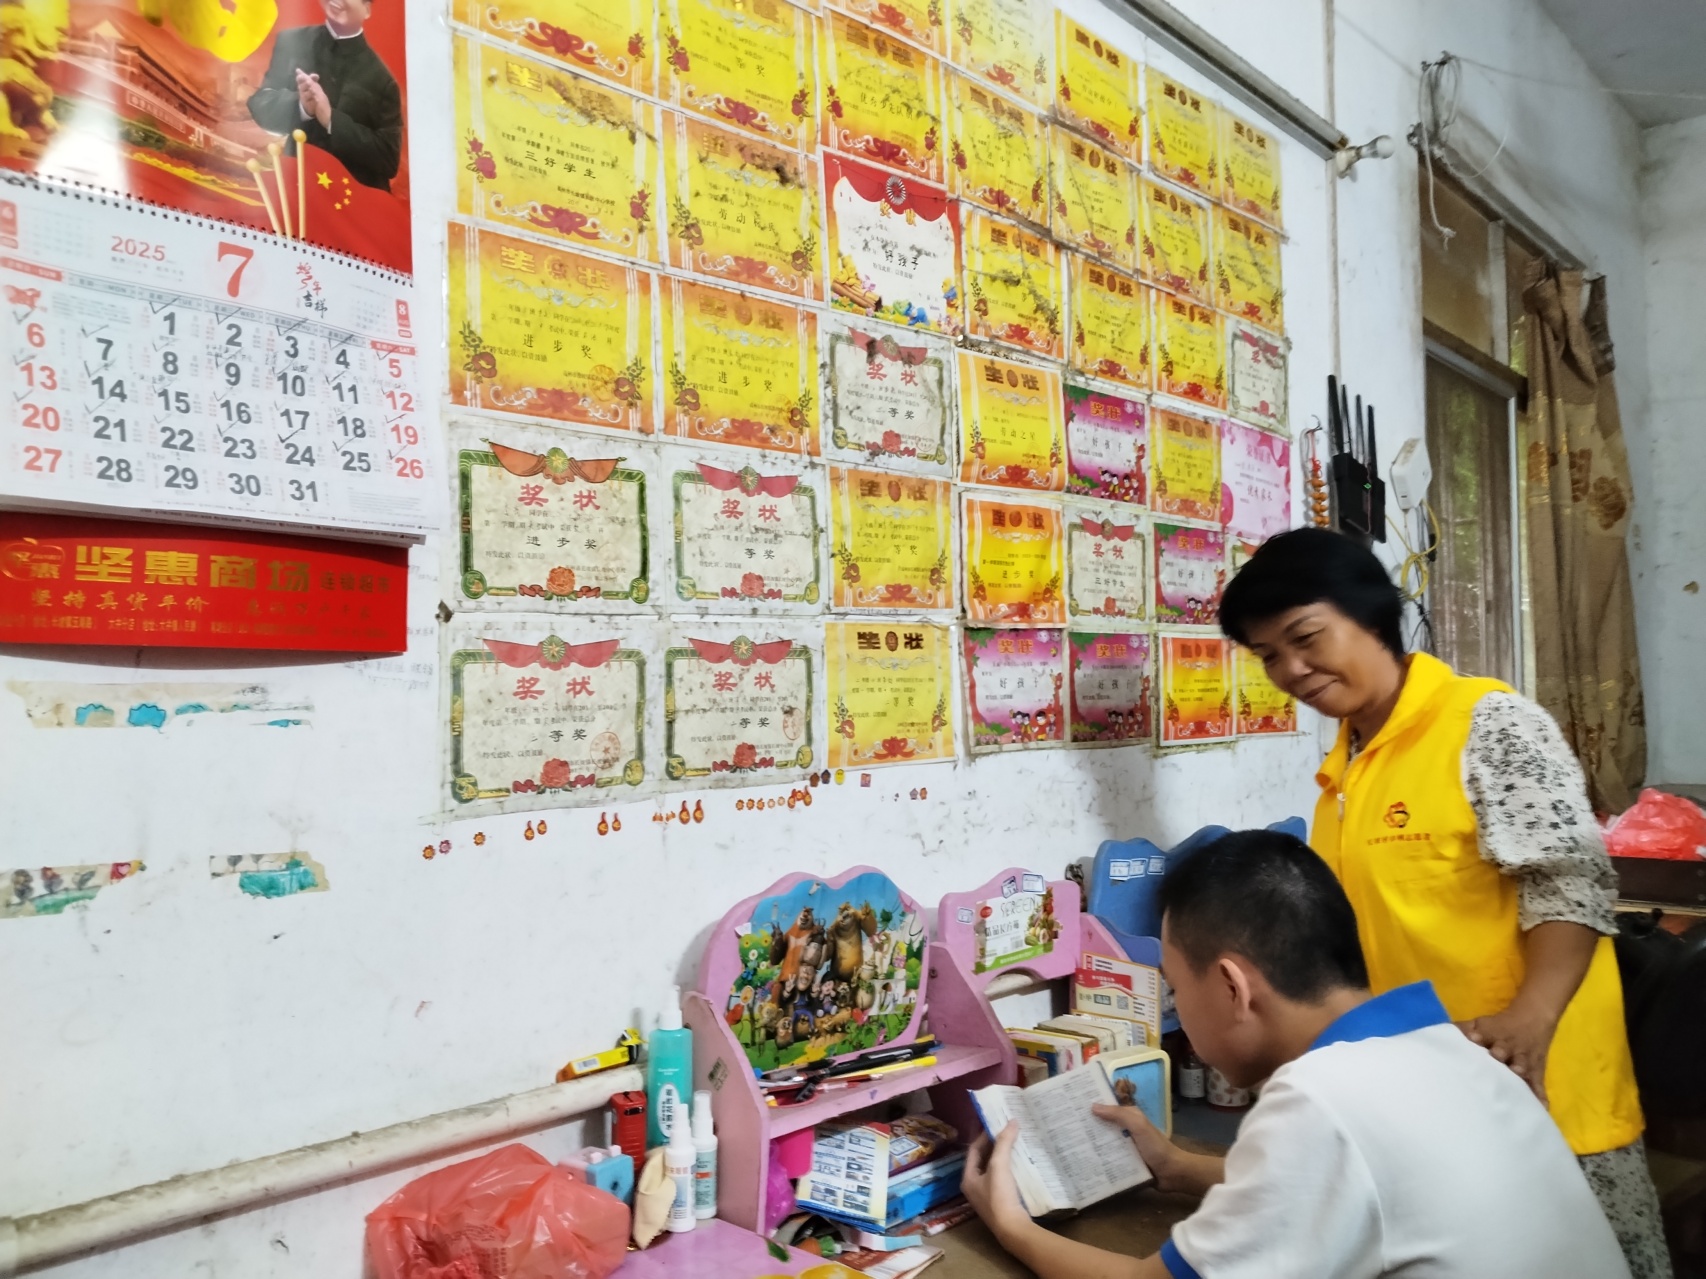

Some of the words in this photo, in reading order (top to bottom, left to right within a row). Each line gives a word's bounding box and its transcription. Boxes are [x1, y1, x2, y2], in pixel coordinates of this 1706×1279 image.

[525, 150, 597, 180] 三好学生
[111, 235, 166, 262] 2025
[217, 241, 254, 298] 7
[108, 284, 127, 294] MON
[398, 304, 406, 316] 8
[27, 323, 46, 347] 6
[163, 312, 176, 335] 1
[226, 324, 243, 347] 2
[523, 333, 592, 360] 进步奖
[96, 338, 113, 361] 7
[284, 337, 299, 359] 3
[336, 349, 350, 370] 4
[162, 351, 179, 375] 8
[225, 363, 241, 386] 9
[389, 359, 402, 378] 5
[866, 361, 919, 387] 奖状
[20, 363, 57, 390] 13
[278, 372, 305, 397] 10
[718, 371, 773, 393] 进步奖
[92, 377, 127, 403] 14
[158, 389, 190, 414] 15
[332, 383, 359, 405] 11
[386, 390, 413, 412] 12
[22, 403, 60, 431] 20
[221, 399, 252, 424] 16
[281, 408, 309, 431] 17
[93, 416, 127, 442] 21
[338, 416, 366, 438] 18
[391, 424, 418, 446] 19
[161, 426, 195, 452] 22
[223, 437, 257, 460] 23
[23, 446, 62, 473] 27
[286, 443, 315, 467] 24
[342, 451, 371, 473] 25
[97, 456, 133, 482] 28
[165, 465, 198, 490] 29
[395, 457, 423, 479] 26
[228, 473, 261, 496] 30
[290, 479, 318, 502] 31
[518, 483, 602, 511] 奖状
[720, 498, 781, 523] 奖状
[525, 535, 598, 550] 进步奖
[1092, 542, 1125, 560] 奖状
[75, 545, 310, 592] 坚惠商场
[512, 675, 596, 701] 奖状
[712, 671, 776, 693] 奖状
